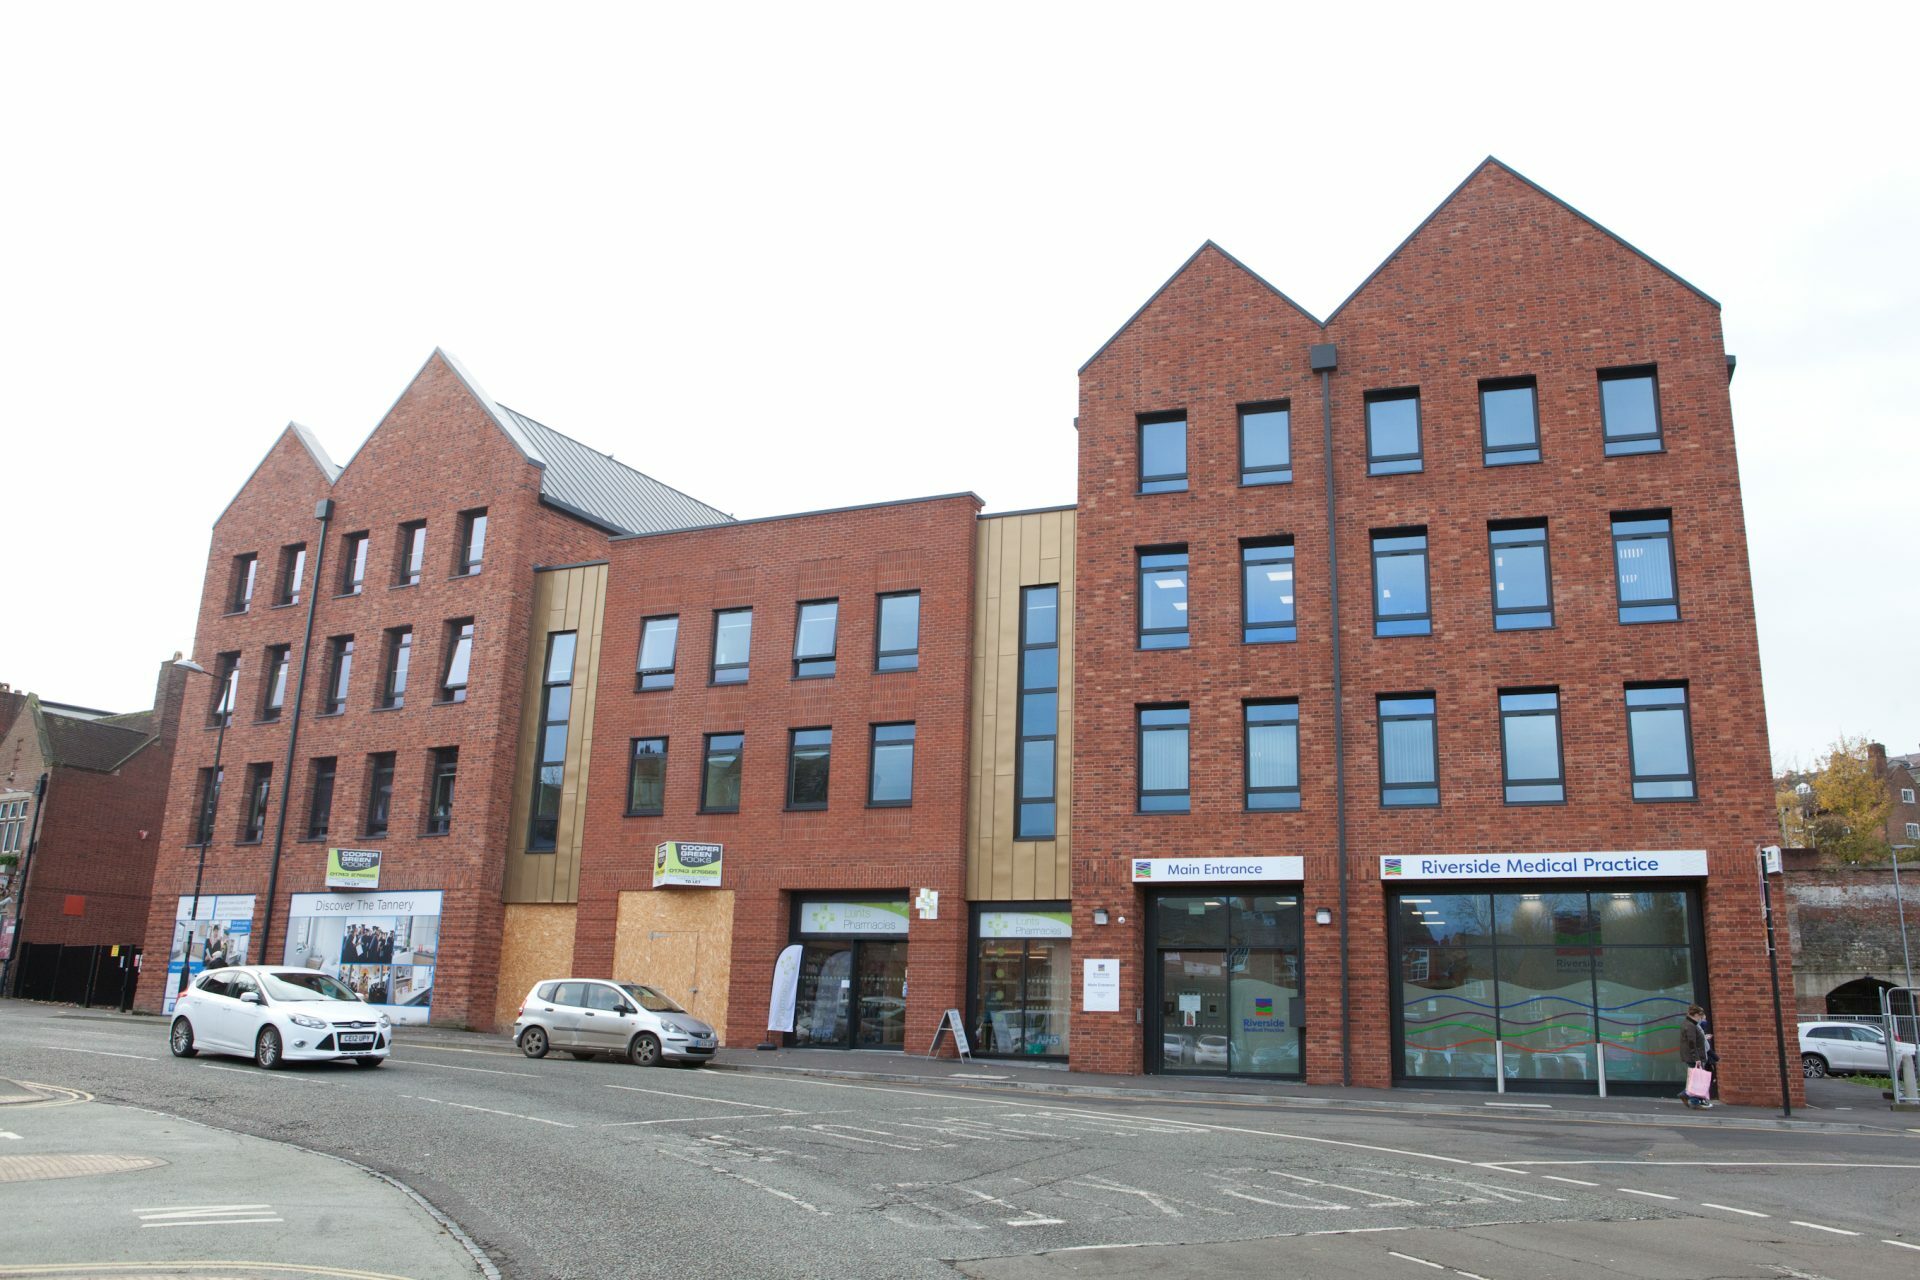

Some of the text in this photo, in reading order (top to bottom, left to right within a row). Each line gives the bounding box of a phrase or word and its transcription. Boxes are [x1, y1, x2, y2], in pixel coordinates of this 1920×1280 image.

[1167, 863, 1263, 875] Main Entrance
[1421, 857, 1659, 874] Riverside Medical Practice
[315, 899, 414, 912] Discover The Tannery
[843, 919, 896, 930] Pharmacies
[1015, 926, 1062, 936] Pharmacies
[1556, 959, 1604, 969] Riversie
[1243, 1018, 1285, 1028] Riverside
[1036, 1034, 1060, 1045] NHS
